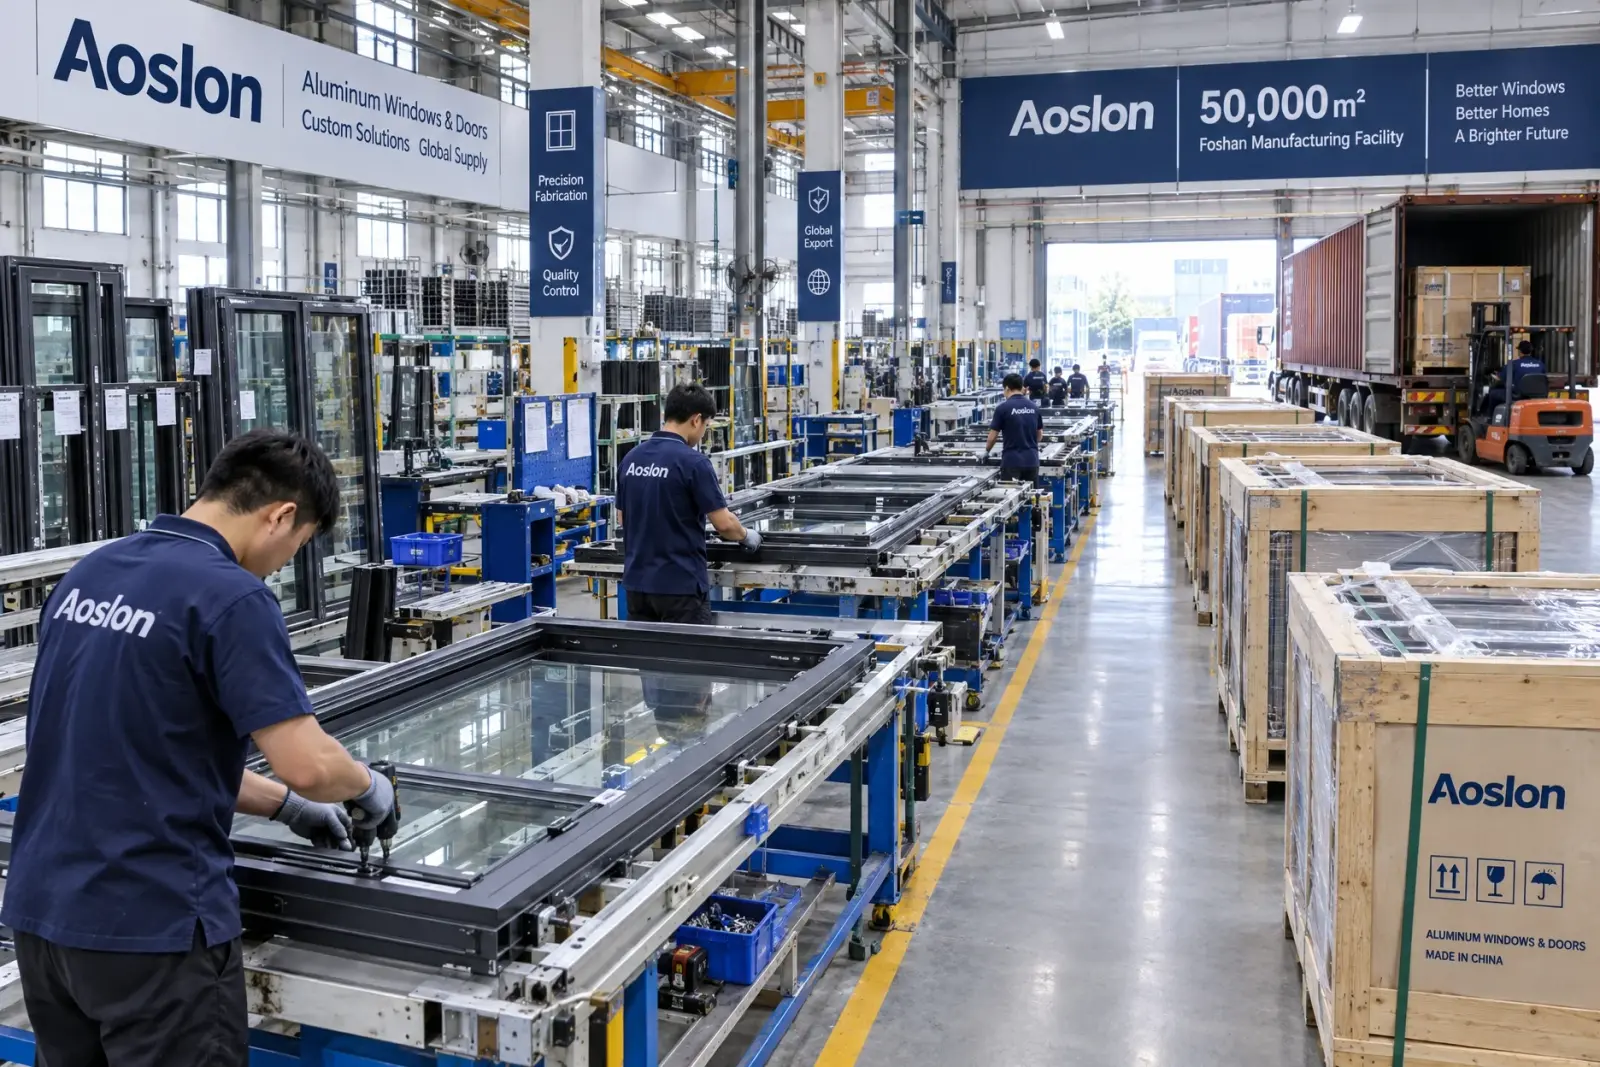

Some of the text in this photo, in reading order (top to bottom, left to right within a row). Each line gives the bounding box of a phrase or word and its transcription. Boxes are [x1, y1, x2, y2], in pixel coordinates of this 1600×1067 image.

[54, 18, 263, 124] Aoslon
[1456, 79, 1566, 98] Better Windows
[302, 70, 488, 140] Aluminum Windows & Doors
[1200, 84, 1328, 128] 50,000
[1456, 105, 1550, 121] Better Homes
[1010, 95, 1154, 137] Aoslon
[302, 109, 488, 175] Custom Solutions Global Supply
[1200, 130, 1404, 152] Foshan Manufacturing Facility
[1455, 126, 1569, 145] A Brighter Future
[538, 174, 584, 186] Precision
[535, 190, 588, 202] Fabrication
[804, 225, 833, 236] Global
[804, 238, 834, 250] Export
[543, 268, 579, 283] Quality
[543, 284, 579, 297] Control
[626, 463, 669, 479] Aoslon
[53, 588, 156, 638] Aoslon
[1428, 773, 1566, 810] Aoslon
[1426, 929, 1587, 952] ALUMINUM WINDOWS & DOORS
[1425, 949, 1504, 966] MADE IN CHINA
